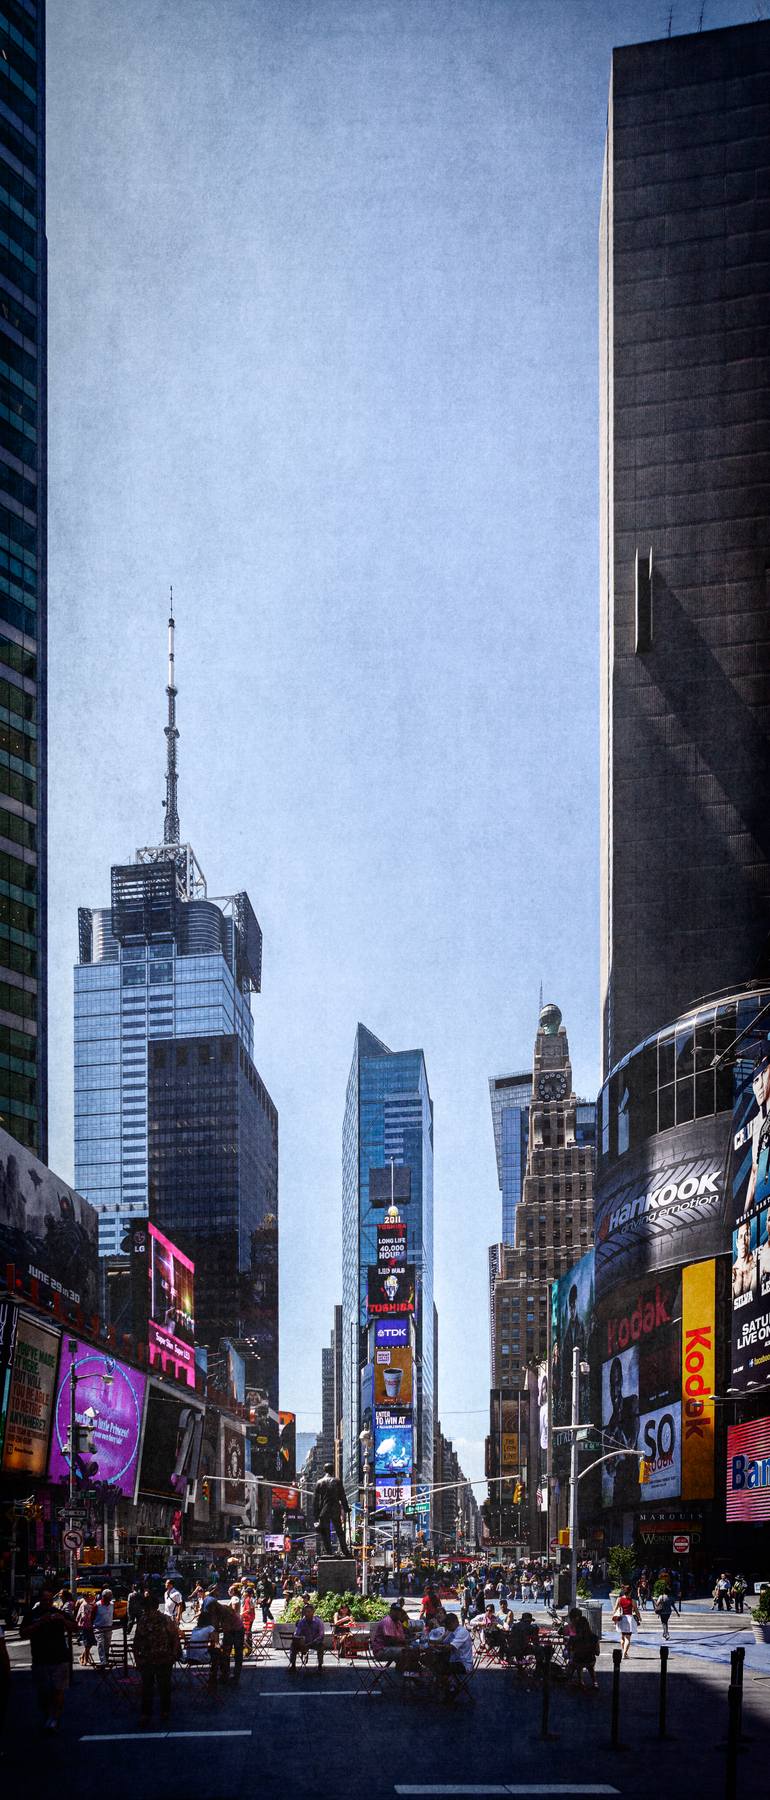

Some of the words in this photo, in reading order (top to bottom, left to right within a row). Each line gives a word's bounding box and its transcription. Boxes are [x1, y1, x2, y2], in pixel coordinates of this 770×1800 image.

[659, 1195, 719, 1217] emotion
[384, 1216, 401, 1224] 2011
[134, 1245, 145, 1253] LG
[50, 1278, 62, 1293] 29
[68, 1290, 80, 1304] 3D
[369, 1304, 414, 1313] TOSHIBA
[733, 1290, 754, 1310] SILVA
[607, 1283, 671, 1357] Kodak
[384, 1328, 407, 1337] TDK
[737, 1330, 758, 1350] LIVE
[685, 1326, 712, 1440] Kodak
[21, 1400, 42, 1417] RETIRE
[376, 1417, 384, 1425] TO
[385, 1416, 398, 1425] WIN
[398, 1416, 406, 1425] AT
[644, 1413, 675, 1460] SO
[383, 1488, 404, 1498] LOUE
[640, 1513, 704, 1521] MARQUIS
